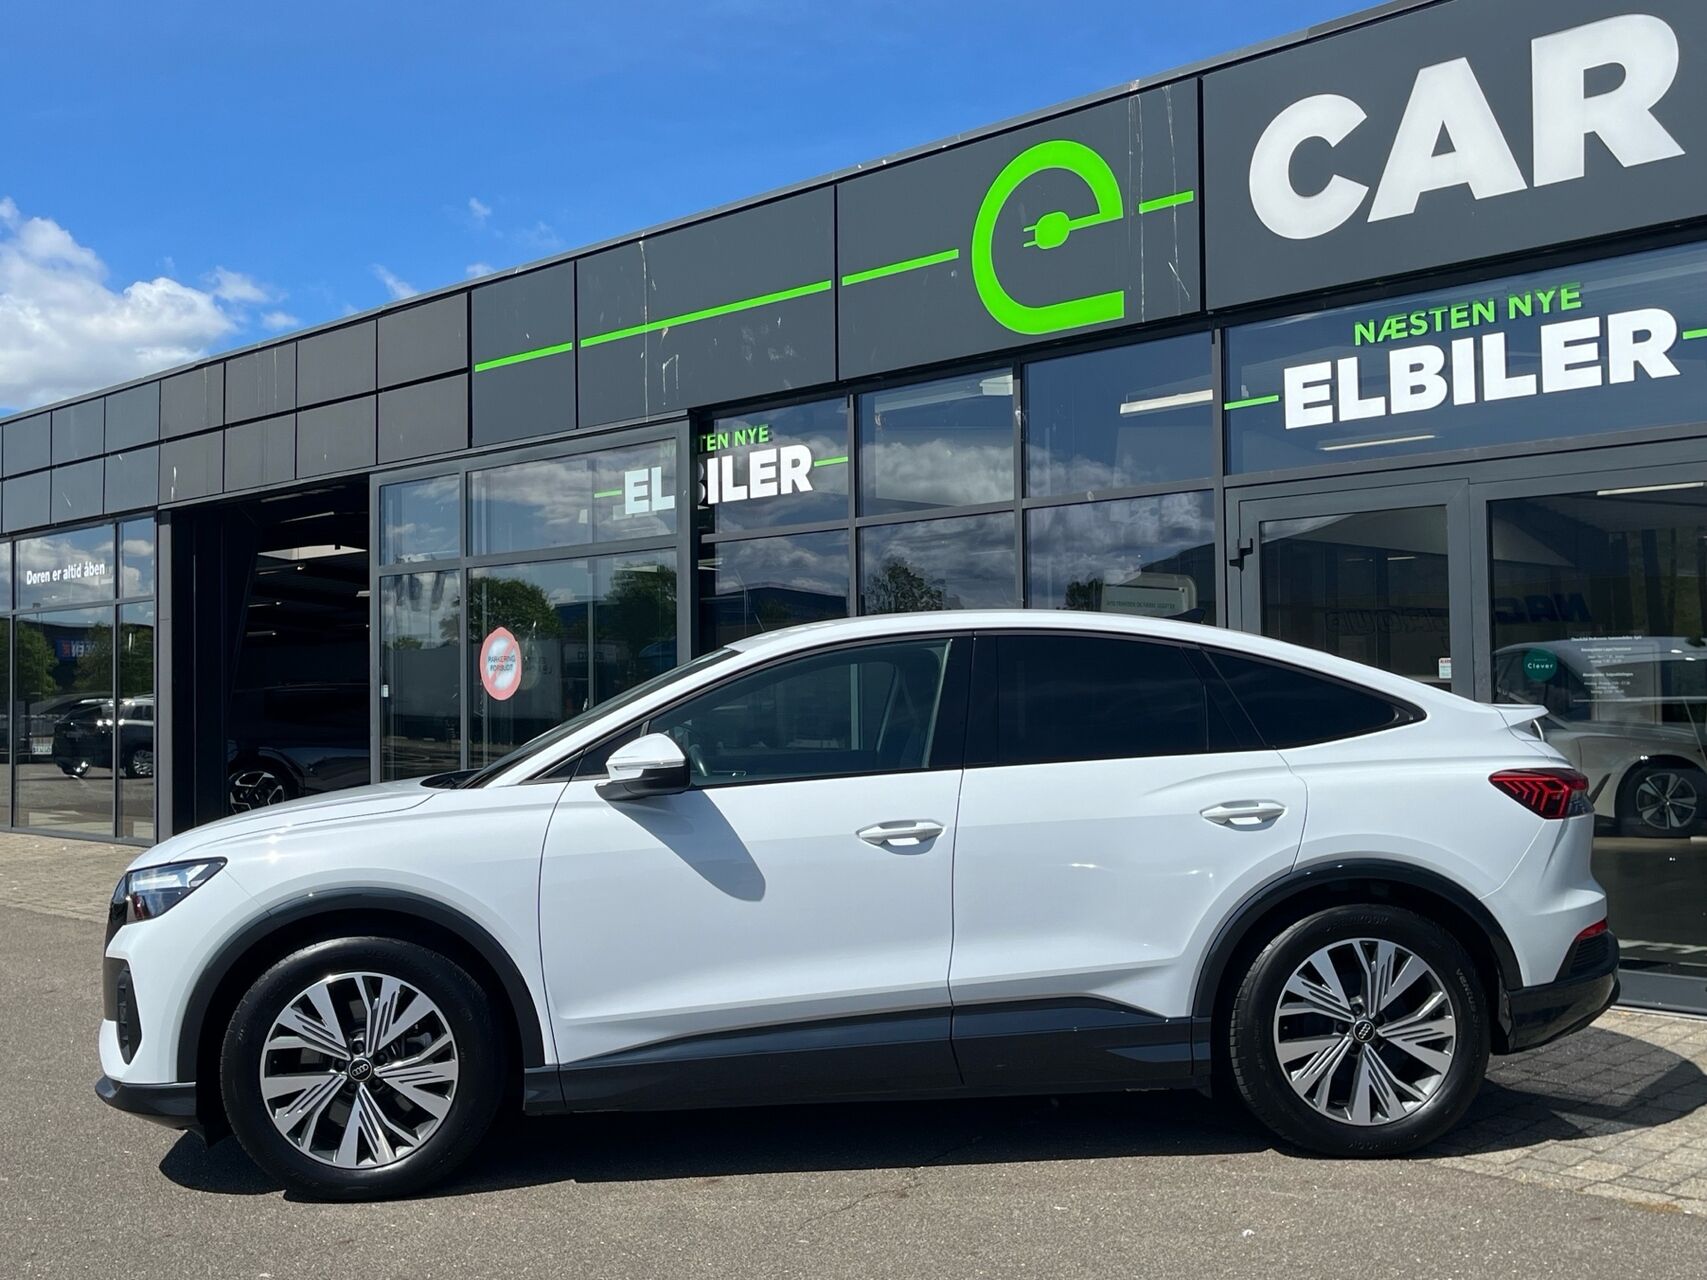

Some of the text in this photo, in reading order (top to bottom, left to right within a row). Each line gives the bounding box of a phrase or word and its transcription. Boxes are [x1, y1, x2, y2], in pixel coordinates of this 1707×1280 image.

[1249, 14, 1686, 240] CAR
[1353, 281, 1583, 346] NÆSTEN NYE
[1283, 308, 1681, 430] ELBILER
[734, 424, 770, 447] NYE
[52, 568, 62, 582] er
[63, 562, 82, 580] altid
[84, 561, 105, 577] åben
[1527, 662, 1554, 670] Clever
